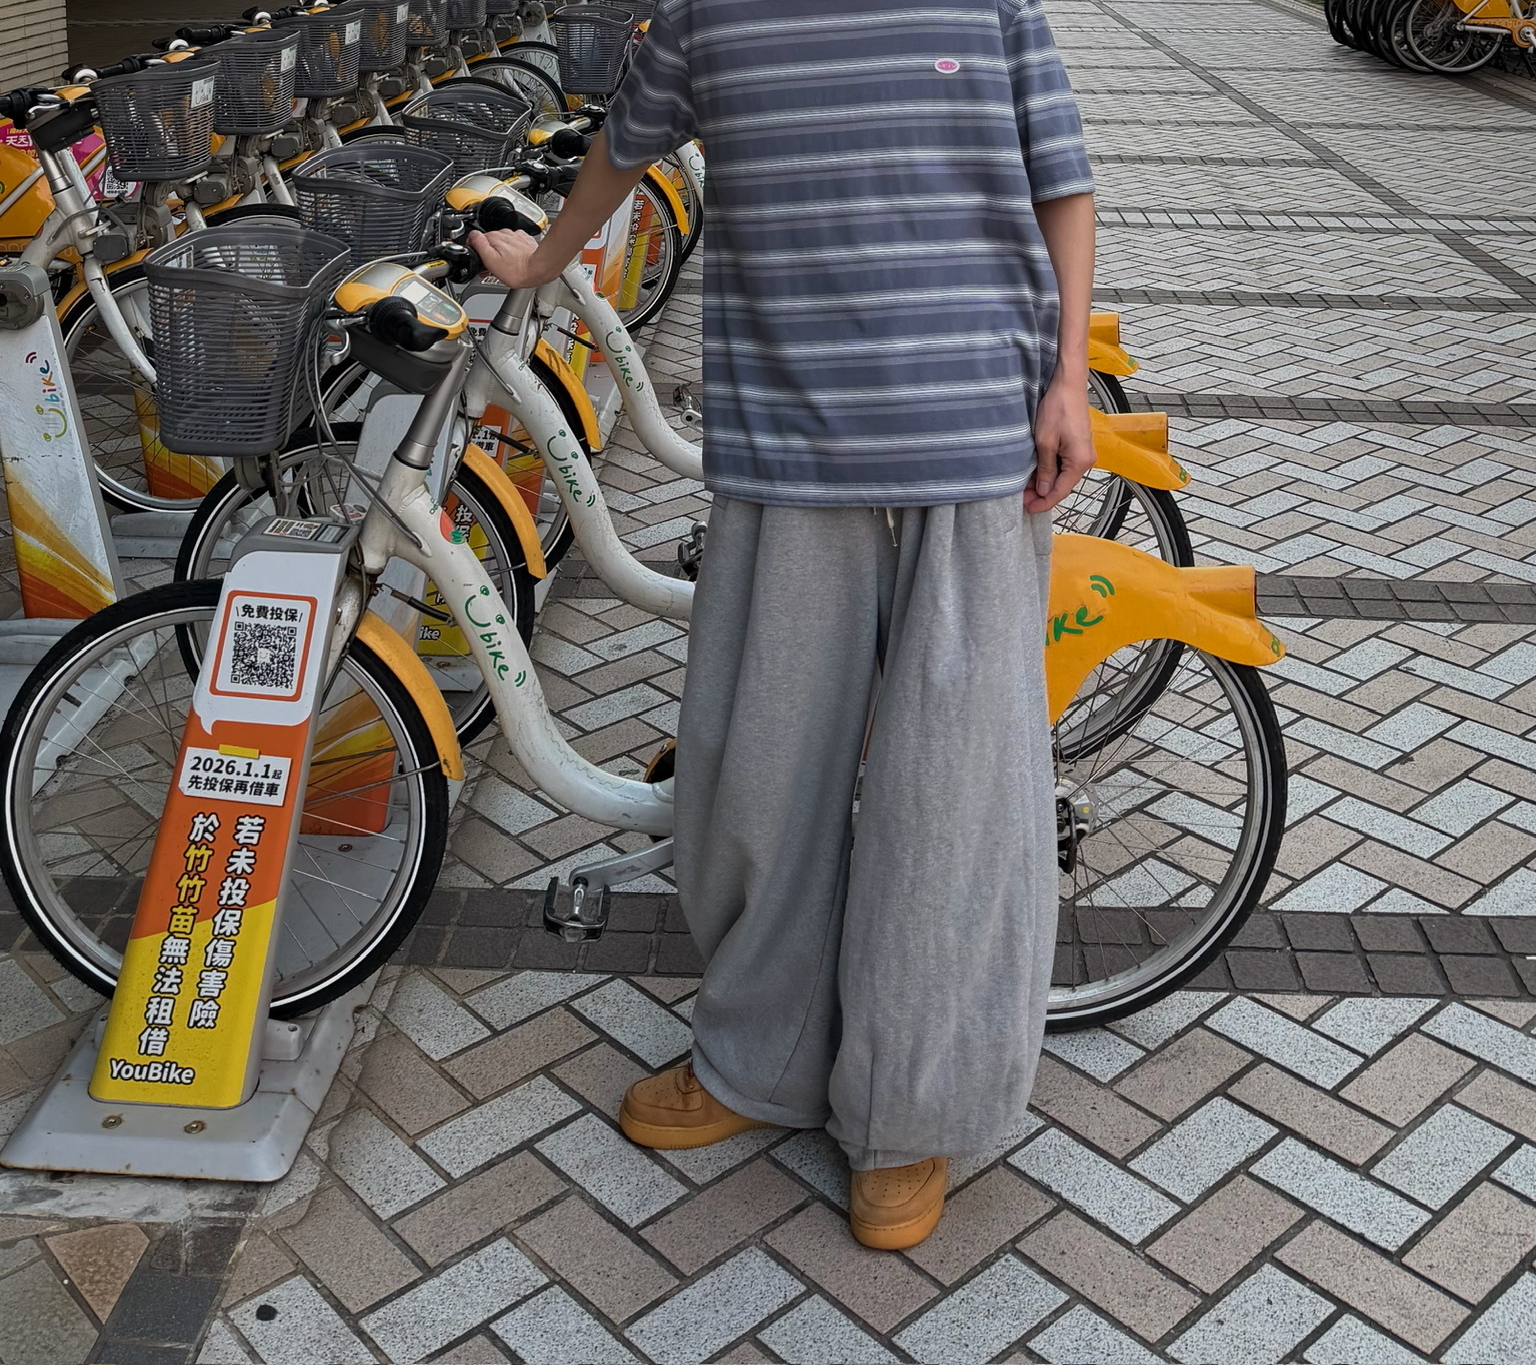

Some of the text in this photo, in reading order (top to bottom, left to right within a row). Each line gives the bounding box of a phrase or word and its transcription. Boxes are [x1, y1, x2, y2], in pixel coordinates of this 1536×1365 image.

[241, 603, 299, 623] 免費投保
[189, 756, 283, 780] 2026.1.1起
[187, 774, 280, 797] 先投保再借車
[187, 814, 265, 1029] 若未投保傷害險
[138, 812, 220, 1057] 於竹竹苗無法租借
[109, 1058, 195, 1085] YouBike
